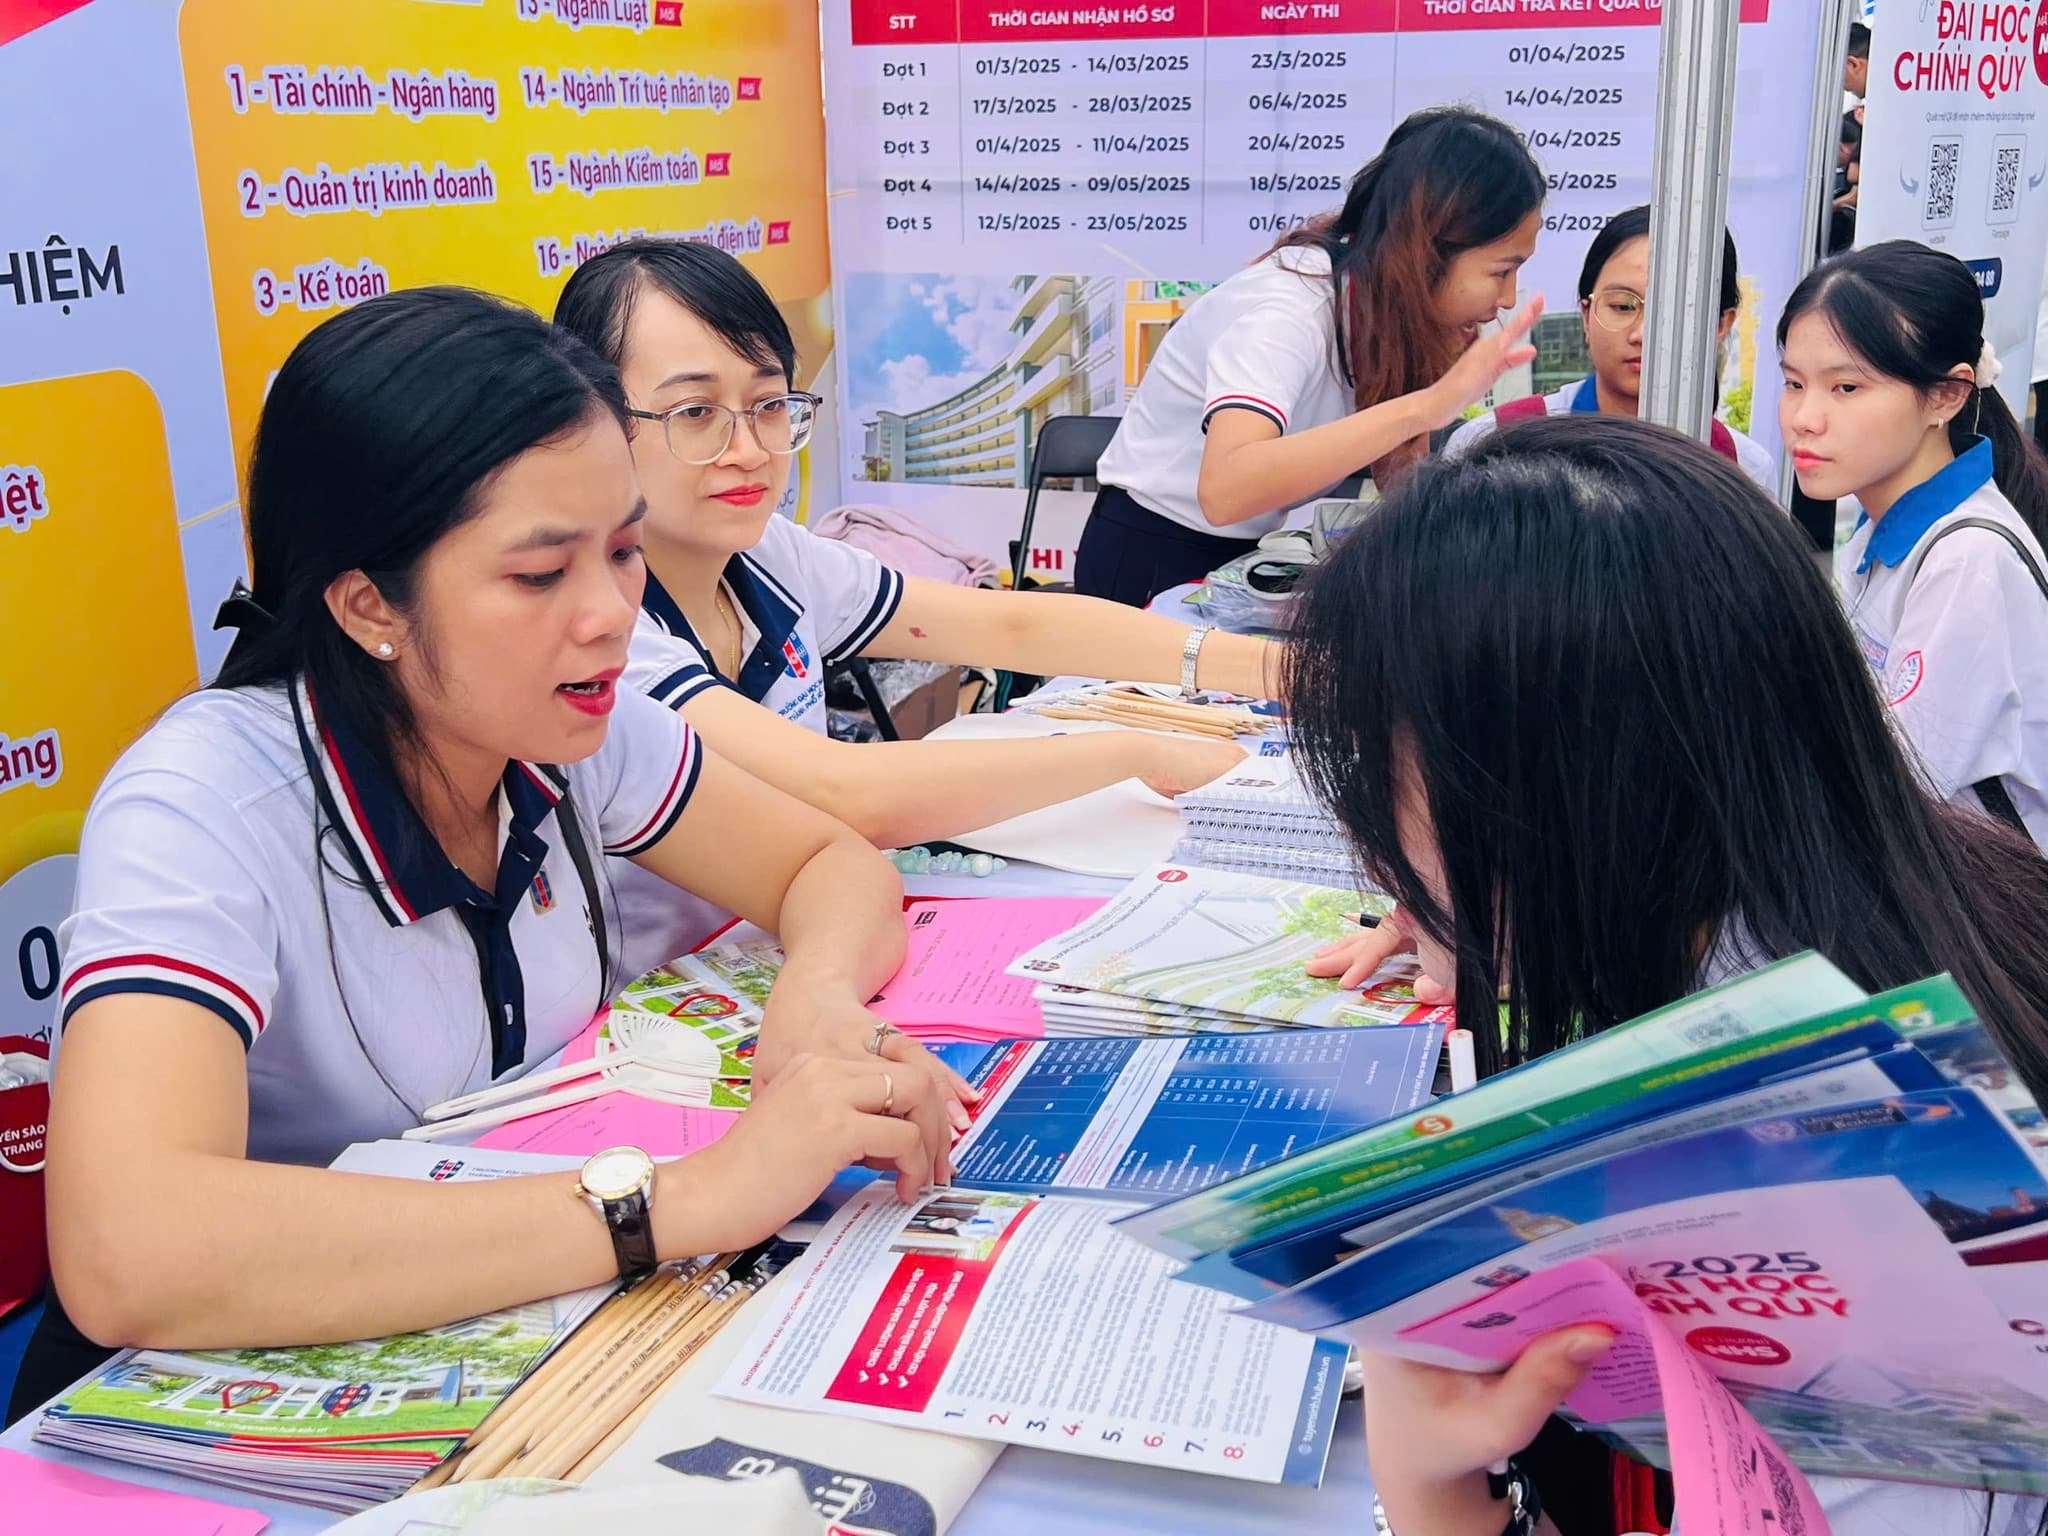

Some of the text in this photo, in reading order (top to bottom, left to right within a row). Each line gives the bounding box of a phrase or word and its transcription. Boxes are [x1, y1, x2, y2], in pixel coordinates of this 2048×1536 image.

[988, 3, 1175, 28] THỜI GIAN NHẬN HỒ SƠ
[1261, 1, 1340, 21] NGÀY THI
[889, 15, 917, 30] STT
[1980, 4, 2030, 52] HỌC
[1250, 51, 1347, 71] 23/3/2025
[1509, 43, 1625, 64] 01/04/2025
[882, 61, 927, 79] Đợt 1
[975, 57, 1061, 75] 01/3/2025
[1088, 55, 1189, 73] 14/03/2025
[1894, 42, 1971, 91] CHÍNH
[230, 73, 243, 106] 1
[269, 72, 307, 107] Tài
[312, 73, 372, 108] chính
[391, 77, 444, 116] Ngân
[448, 76, 495, 116] hàng
[523, 74, 545, 101] 14
[562, 73, 615, 109] Ngành
[619, 75, 640, 102] Trí
[645, 77, 667, 109] tuệ
[671, 77, 705, 104] nhân
[709, 80, 730, 109] tạo
[1506, 87, 1623, 107] 14/04/2025
[882, 100, 930, 119] Đợt 2
[973, 97, 1057, 115] 17/3/2025
[1089, 96, 1192, 114] 28/03/2025
[1248, 92, 1347, 111] 06/4/2025
[883, 139, 930, 157] Đợt 3
[975, 136, 1061, 155] 01/4/2025
[1093, 135, 1190, 154] 11/04/2025
[1248, 133, 1345, 153] 20/4/2025
[1517, 129, 1622, 149] /04/2025
[530, 160, 552, 187] 15
[570, 156, 622, 191] Ngành
[625, 152, 663, 183] Kiểm
[667, 154, 698, 181] toán
[243, 176, 260, 210] 2
[285, 164, 348, 210] Quản
[352, 170, 378, 210] trị
[382, 168, 428, 202] kinh
[433, 166, 493, 200] doanh
[884, 177, 932, 195] Đợt 4
[975, 175, 1061, 194] 14/4/2025
[1087, 175, 1190, 193] 09/05/2025
[1249, 174, 1341, 192] 18/5/2025
[1547, 172, 1617, 191] 5/2025
[886, 214, 932, 233] Đợt 5
[977, 214, 1061, 233] 12/5/2025
[1087, 214, 1187, 233] 23/05/2025
[538, 243, 560, 272] 16
[258, 276, 274, 308] 3
[299, 265, 330, 304] Kế
[335, 265, 386, 300] toán
[3, 1139, 43, 1157] TRANG
[1649, 1251, 1821, 1277] 2025
[1634, 1278, 1691, 1298] ẠI
[944, 1408, 966, 1418] 1.
[988, 1411, 1011, 1426] 2.
[1026, 1417, 1049, 1432] 3.
[1062, 1420, 1084, 1436] 4.
[1101, 1427, 1124, 1443] 5.
[1144, 1432, 1166, 1448] 6.
[1184, 1438, 1208, 1454] 7.
[1224, 1443, 1246, 1460] 8.
